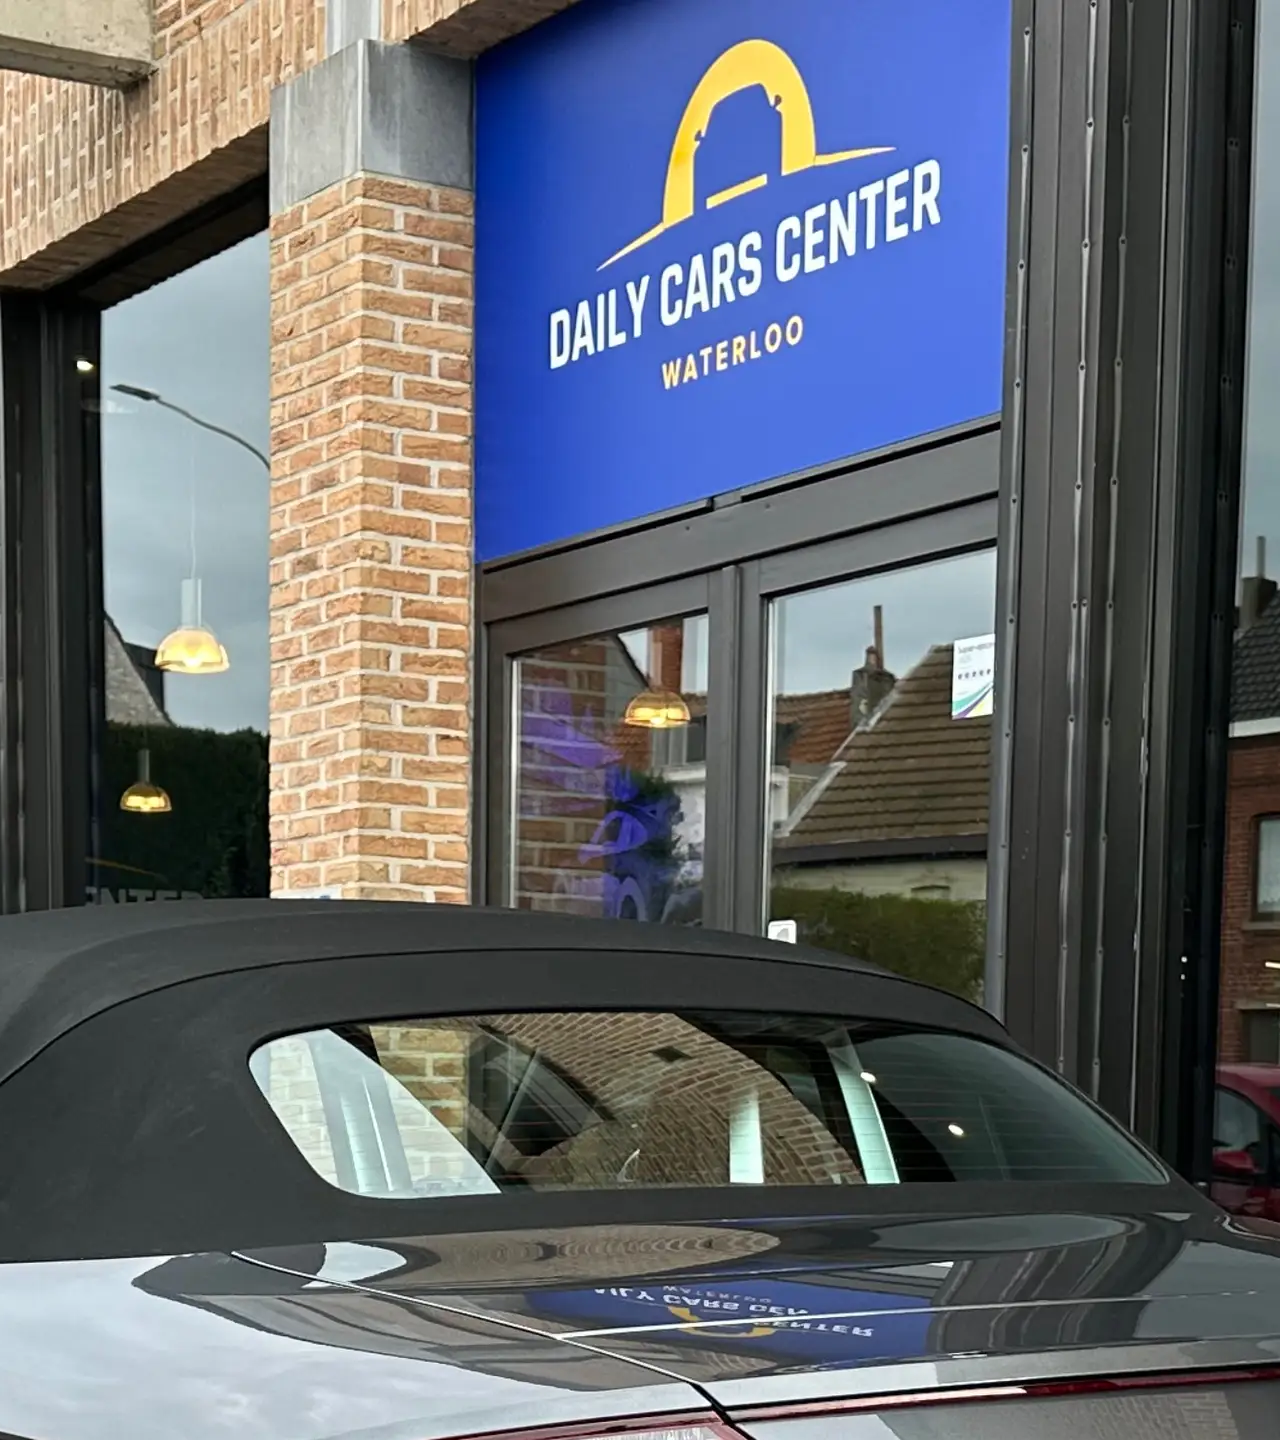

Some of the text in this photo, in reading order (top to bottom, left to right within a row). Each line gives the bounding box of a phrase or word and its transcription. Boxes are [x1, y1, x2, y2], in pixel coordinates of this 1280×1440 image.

[549, 158, 942, 370] DAILY CARS CENTER
[661, 314, 804, 390] WATERLOO
